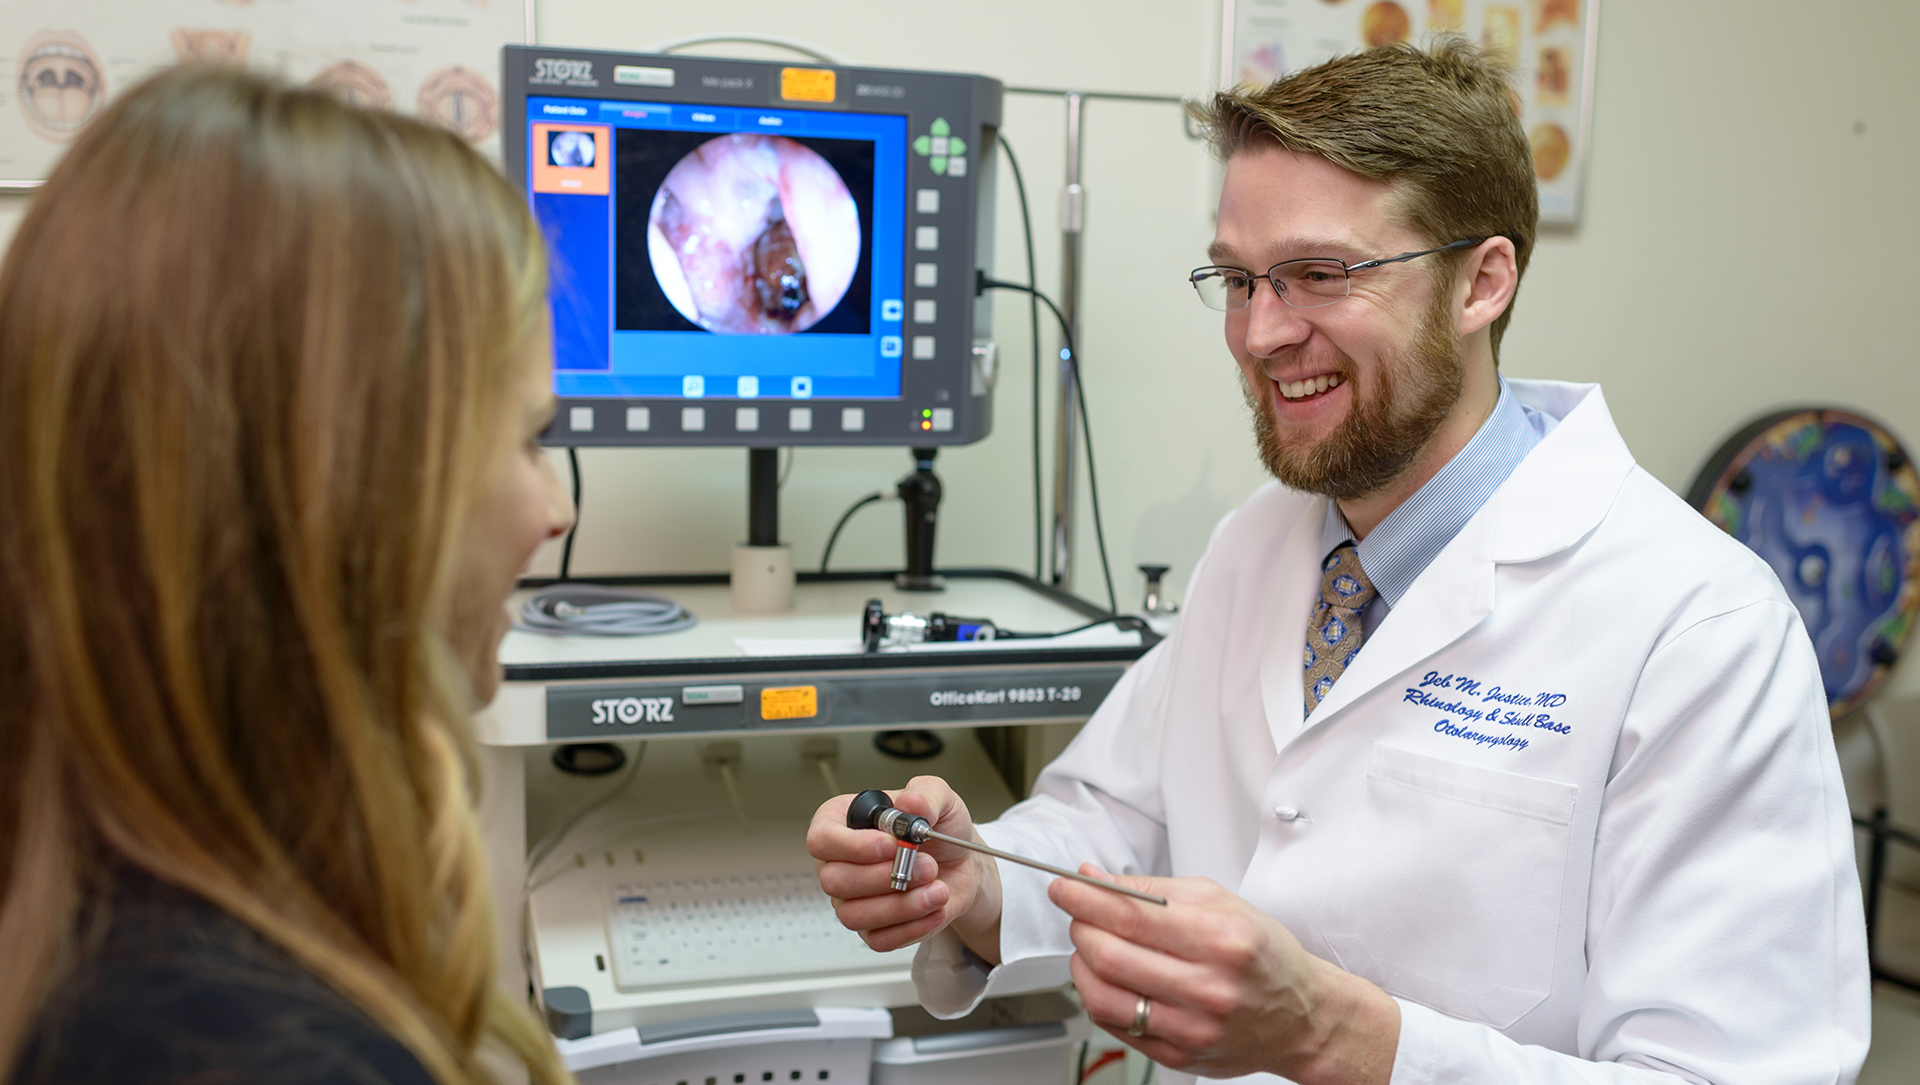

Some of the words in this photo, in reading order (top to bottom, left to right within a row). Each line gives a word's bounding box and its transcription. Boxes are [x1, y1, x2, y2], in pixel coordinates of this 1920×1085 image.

[535, 58, 593, 81] STORZ
[930, 689, 1005, 706] OfficeKart
[1047, 686, 1082, 702] T-20
[1418, 671, 1454, 688] Jeb
[1455, 676, 1481, 696] M.
[1535, 692, 1567, 708] MD
[591, 697, 674, 724] STORZ
[1403, 688, 1484, 722] Rhinology
[1485, 708, 1501, 722] &
[1499, 711, 1536, 727] Skull
[1533, 713, 1572, 735] Base
[1433, 719, 1529, 751] Otolaryngology
